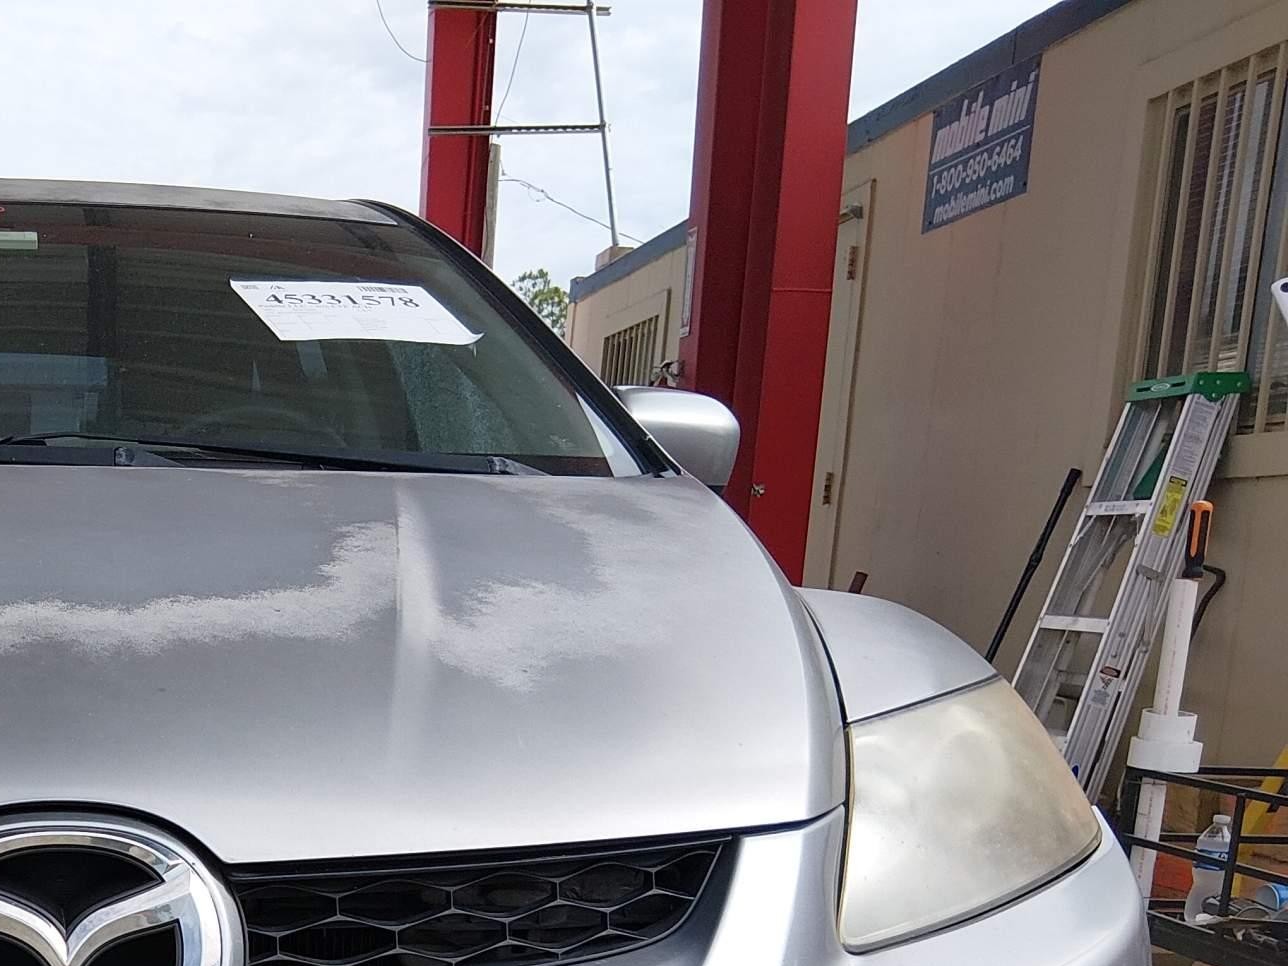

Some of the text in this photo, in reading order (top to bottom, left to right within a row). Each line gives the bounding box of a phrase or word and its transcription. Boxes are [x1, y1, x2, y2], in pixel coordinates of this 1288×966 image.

[931, 71, 1037, 164] mobile mini
[932, 135, 1024, 198] 1-800-950-6464
[933, 176, 1015, 224] mobilemini.com
[265, 293, 420, 308] 45331578
